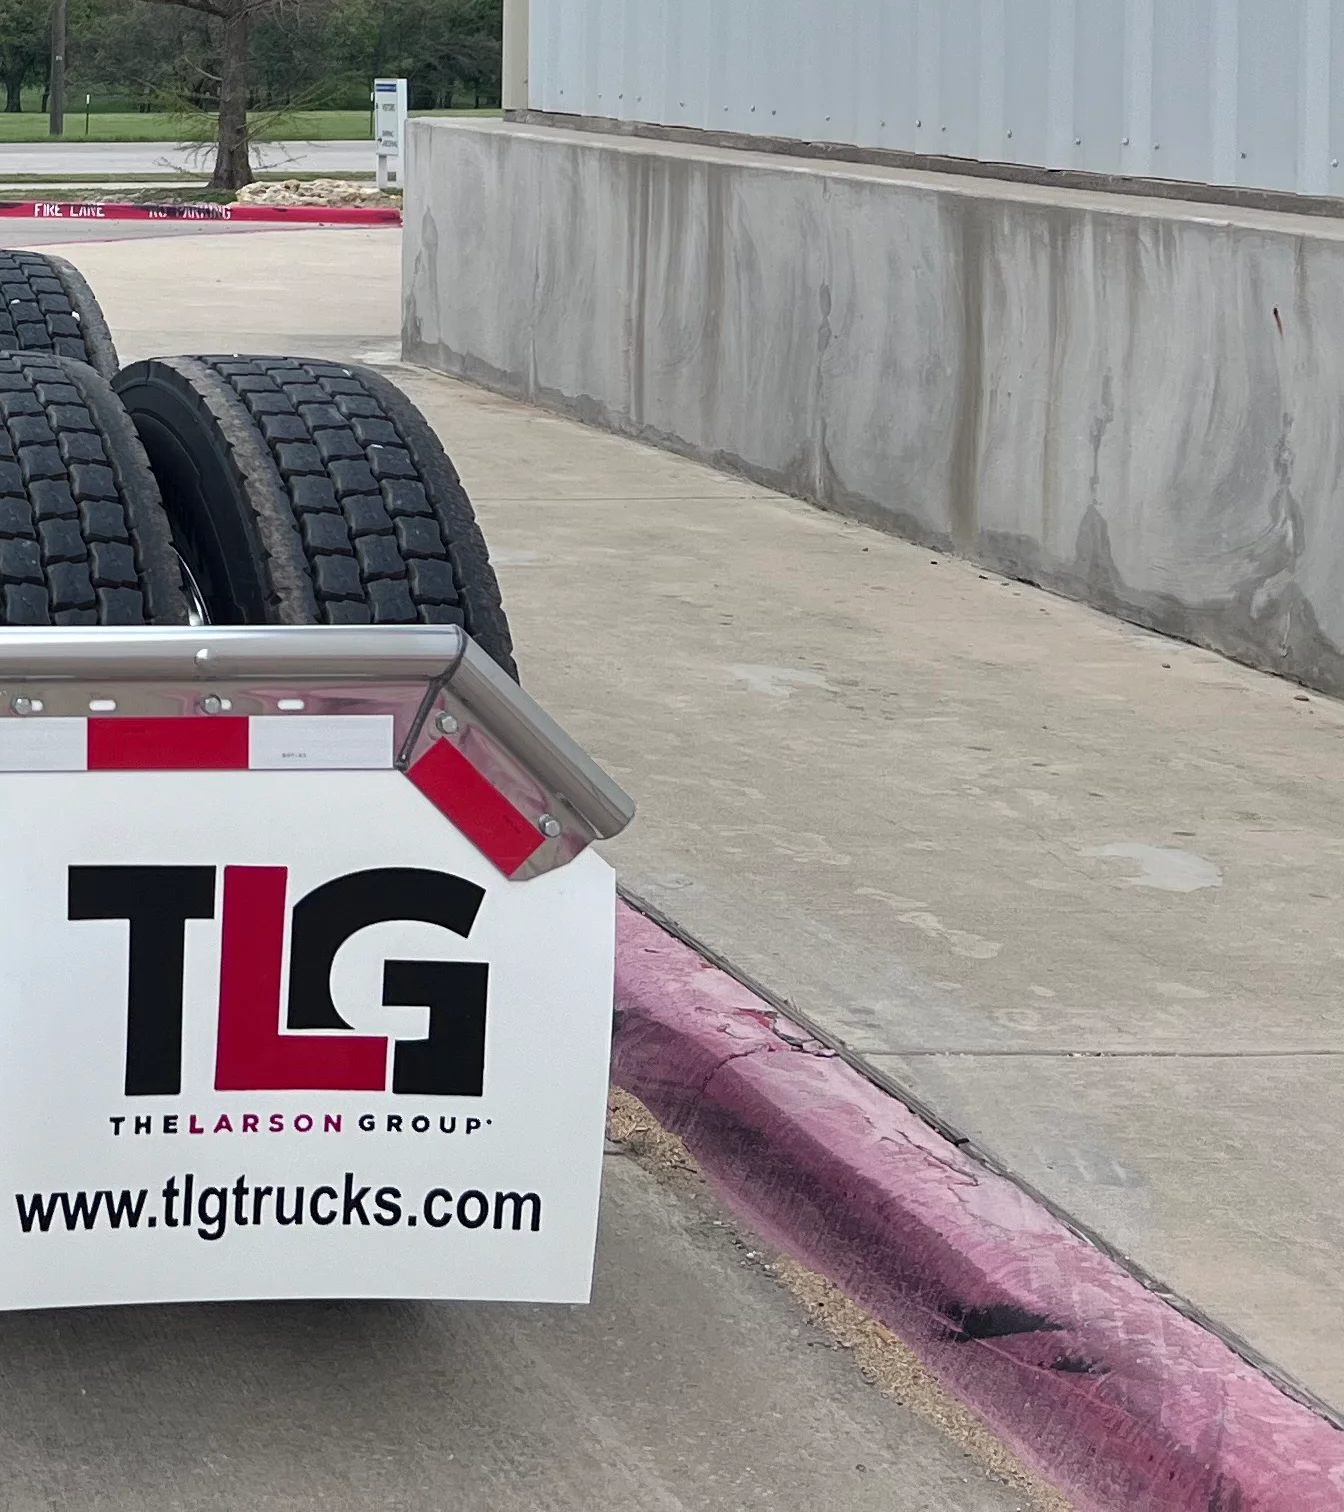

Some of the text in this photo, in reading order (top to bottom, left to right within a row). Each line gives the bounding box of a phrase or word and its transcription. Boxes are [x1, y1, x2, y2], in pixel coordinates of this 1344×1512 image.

[34, 202, 63, 218] FIRE
[69, 202, 105, 217] LANE
[67, 864, 490, 1097] TLG
[358, 1114, 480, 1136] GROUP
[15, 1172, 542, 1241] www.tlgtrucks.com
